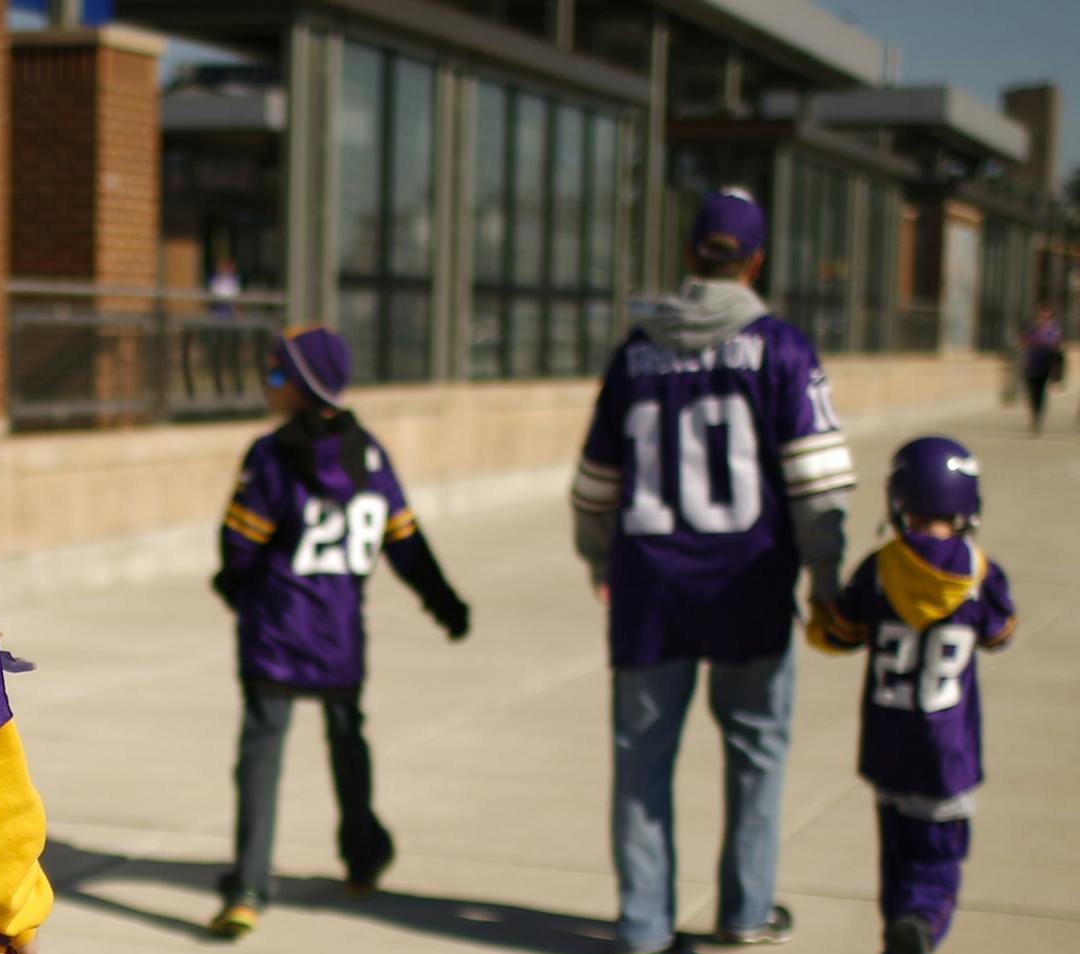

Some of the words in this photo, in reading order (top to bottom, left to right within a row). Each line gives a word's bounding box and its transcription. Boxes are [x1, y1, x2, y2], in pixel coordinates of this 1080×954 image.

[623, 393, 762, 534] 10
[292, 493, 388, 576] 28
[873, 619, 976, 714] 28
